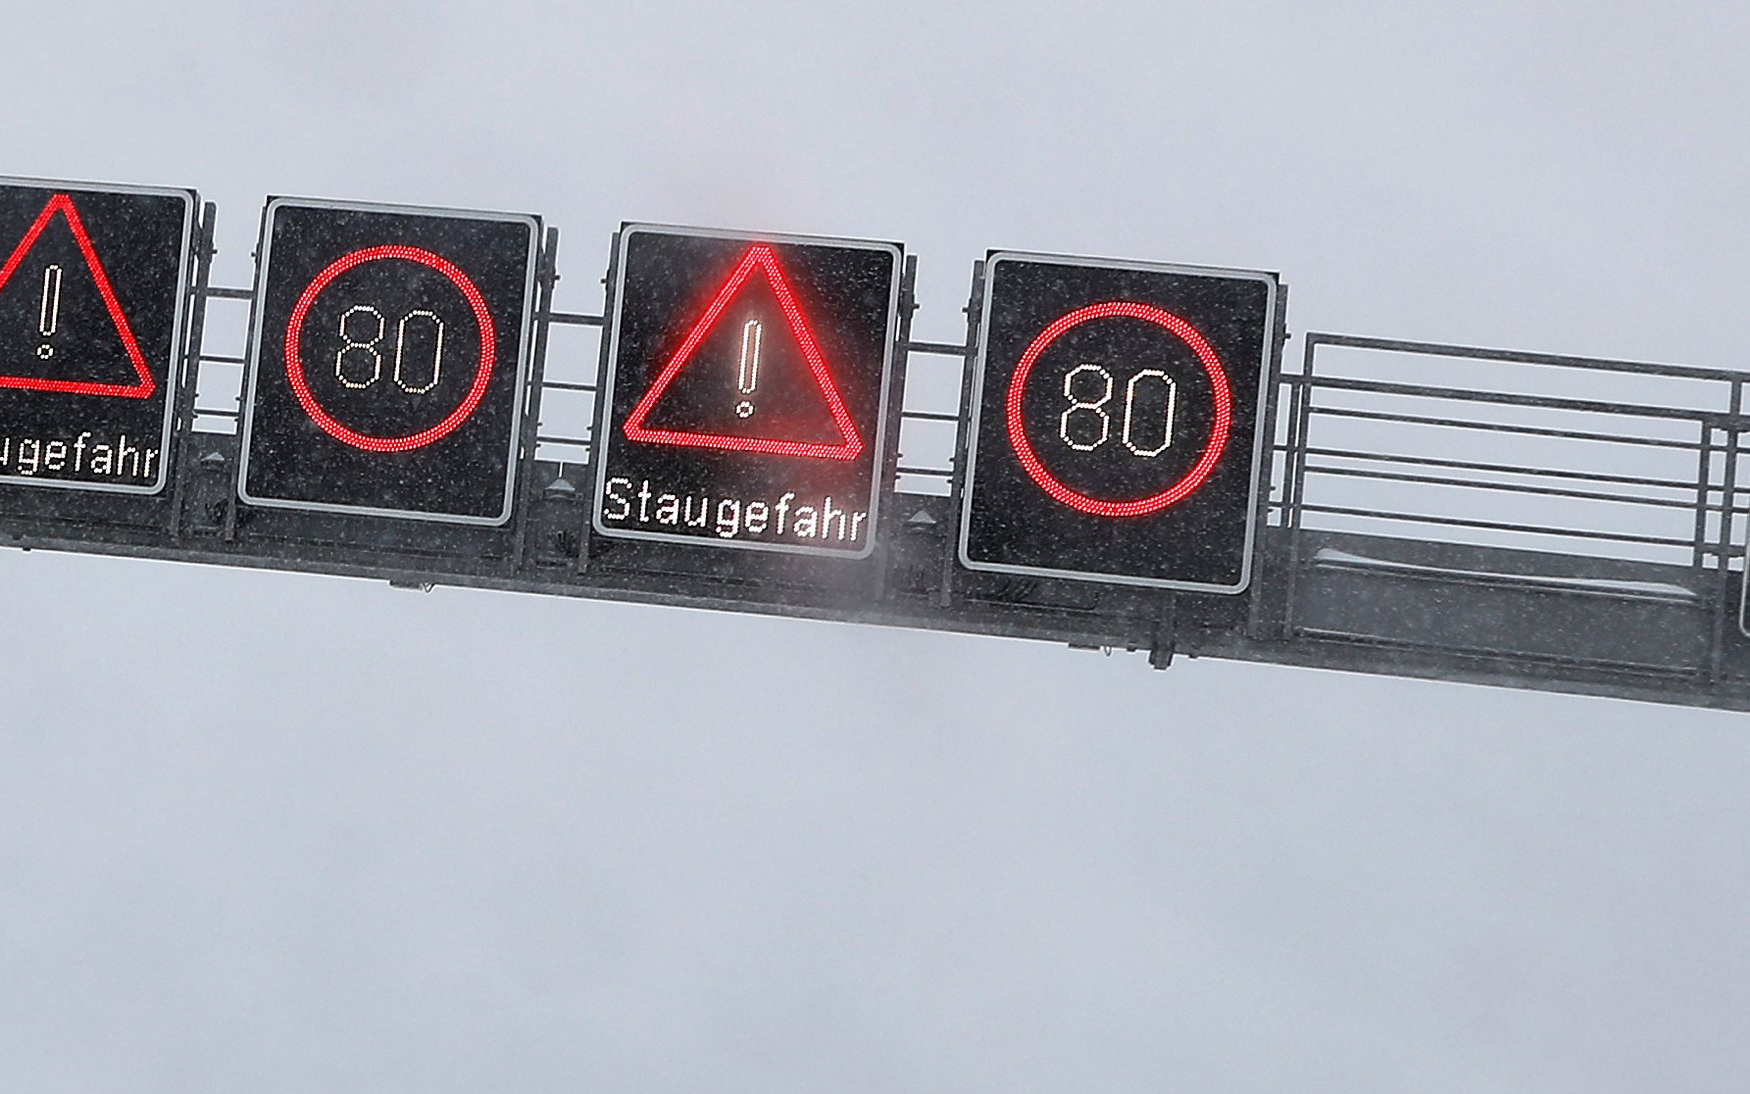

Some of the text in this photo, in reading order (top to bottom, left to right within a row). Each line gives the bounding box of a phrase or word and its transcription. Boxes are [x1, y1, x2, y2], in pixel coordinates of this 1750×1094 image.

[334, 305, 443, 394] 80
[1060, 363, 1178, 458] 80
[604, 476, 869, 543] Staugefahr
